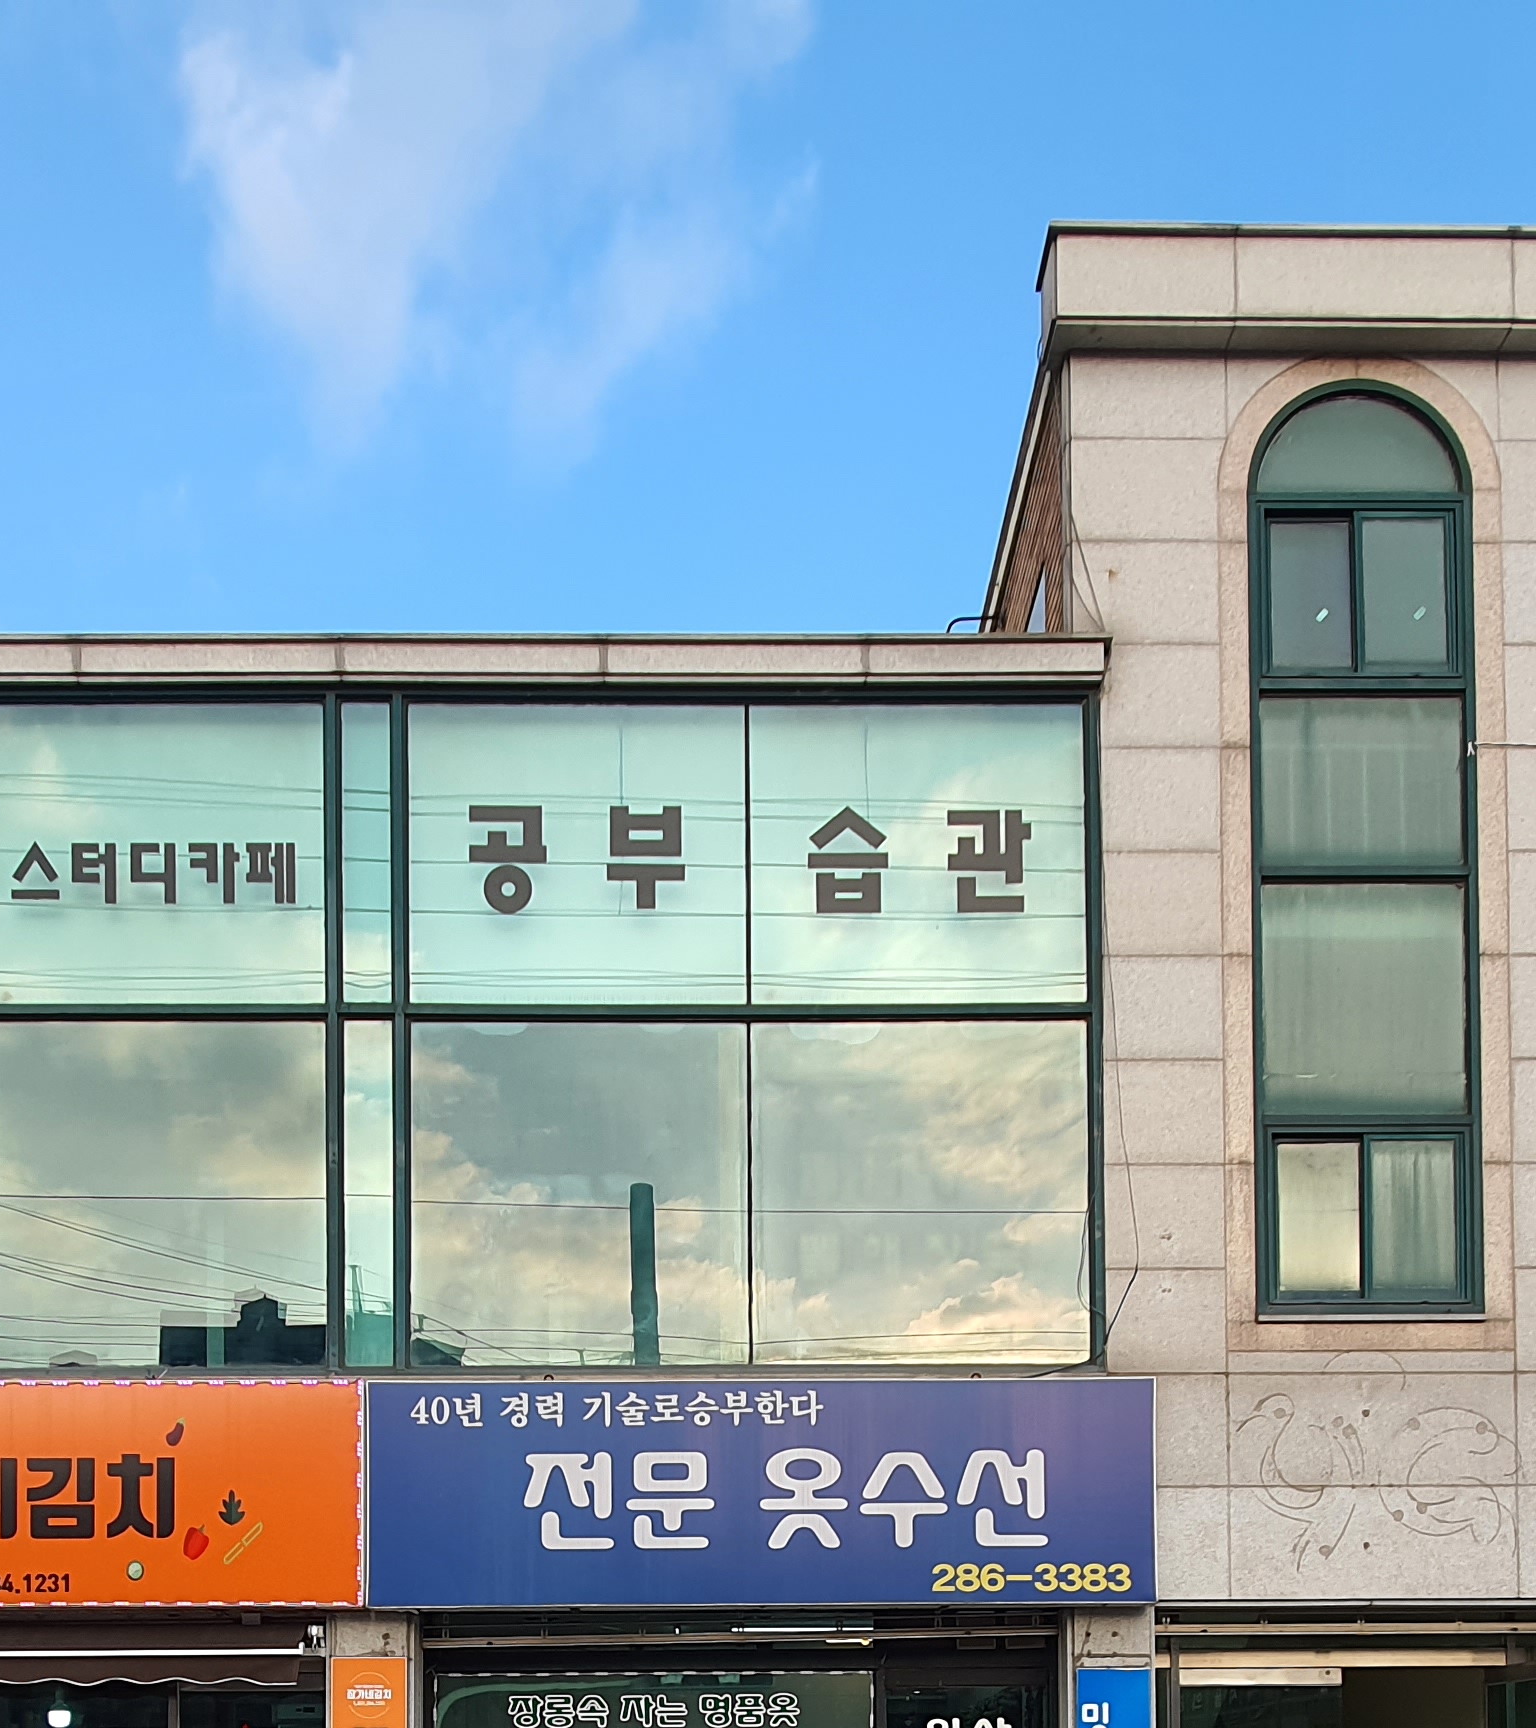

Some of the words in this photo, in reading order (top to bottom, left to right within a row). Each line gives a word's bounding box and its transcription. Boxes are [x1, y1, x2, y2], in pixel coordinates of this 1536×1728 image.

[11, 841, 296, 904] 스터디카페
[469, 805, 685, 914] 공부
[808, 806, 1031, 913] 습관
[410, 1395, 484, 1427] 40년
[500, 1393, 564, 1427] 경력
[583, 1390, 824, 1427] 기술로승부한다
[522, 1448, 715, 1551] 전문
[760, 1447, 1048, 1550] 옷수선
[932, 1563, 1131, 1593] 286-3383
[619, 1694, 688, 1728] 자는
[699, 1692, 800, 1728] 명품옷
